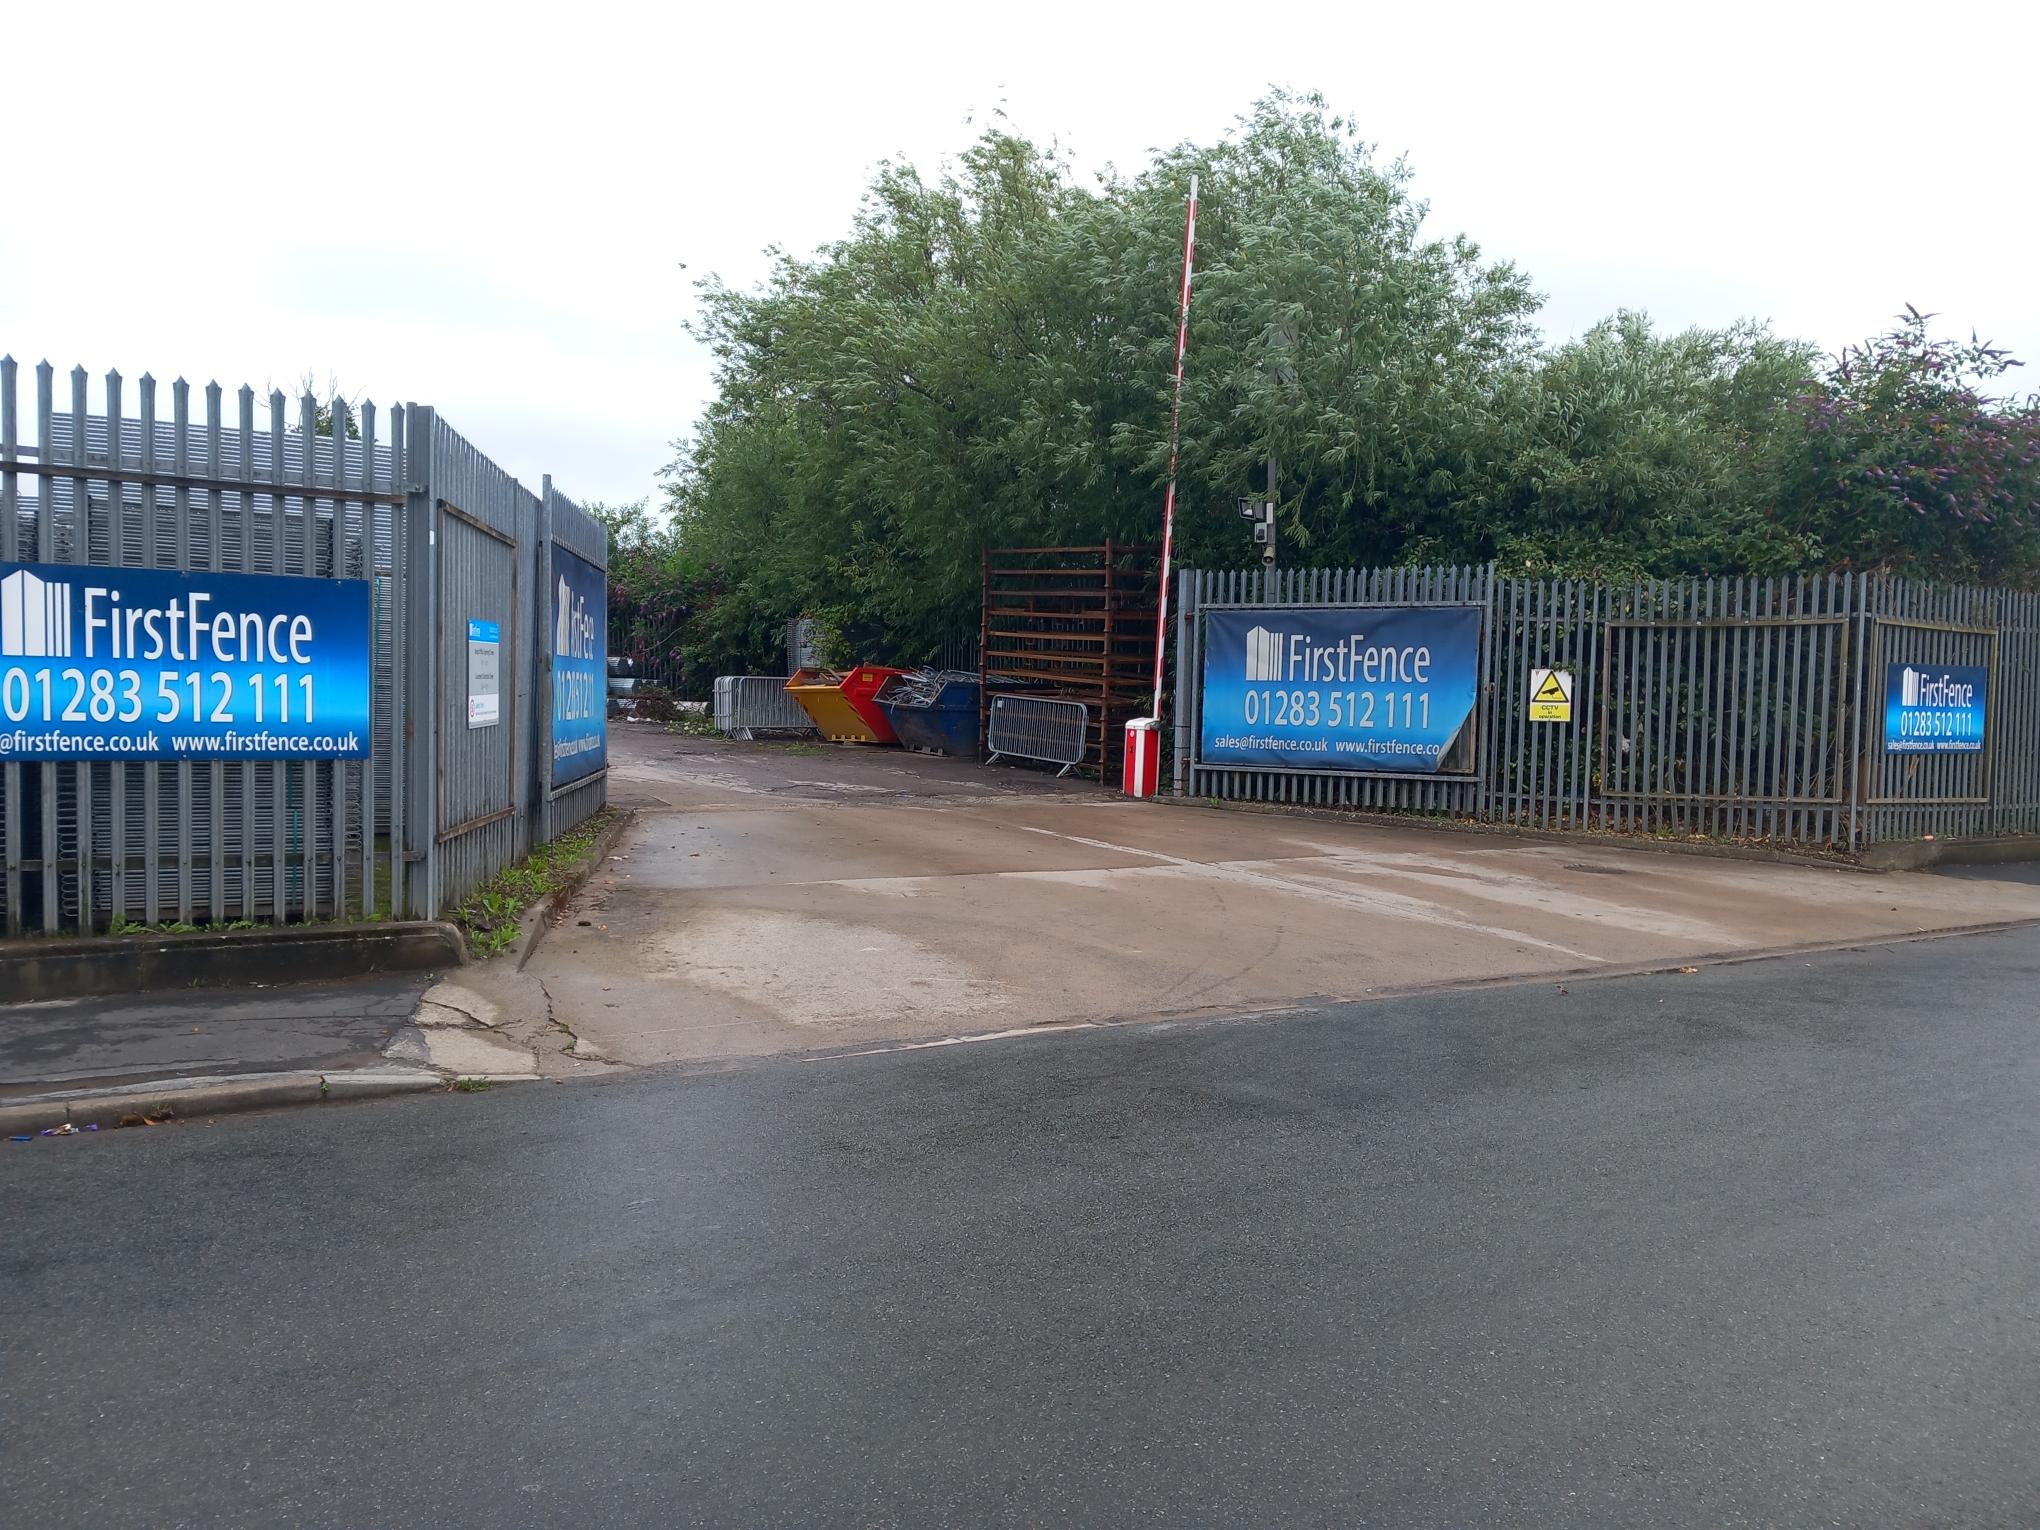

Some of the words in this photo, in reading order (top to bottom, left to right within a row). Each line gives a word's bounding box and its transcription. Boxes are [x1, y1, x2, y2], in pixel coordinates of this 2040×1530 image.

[84, 586, 313, 664] FirstFence
[1289, 634, 1431, 683] FirstFence
[2, 667, 142, 722] 01283
[156, 671, 234, 723] 512
[248, 673, 313, 723] 111
[1921, 674, 1973, 707] FirstFence
[1244, 690, 1320, 727] 01283
[1327, 691, 1374, 728] 512
[1385, 692, 1429, 729] 111
[1901, 711, 1932, 737] 01283
[1934, 711, 1953, 737] 512
[1955, 712, 1972, 737] 111
[0, 729, 160, 754] @firstfence.co.uk
[172, 731, 358, 752] www.firstfence.co.uk
[1214, 733, 1328, 752] sales@firstfence.co.uk
